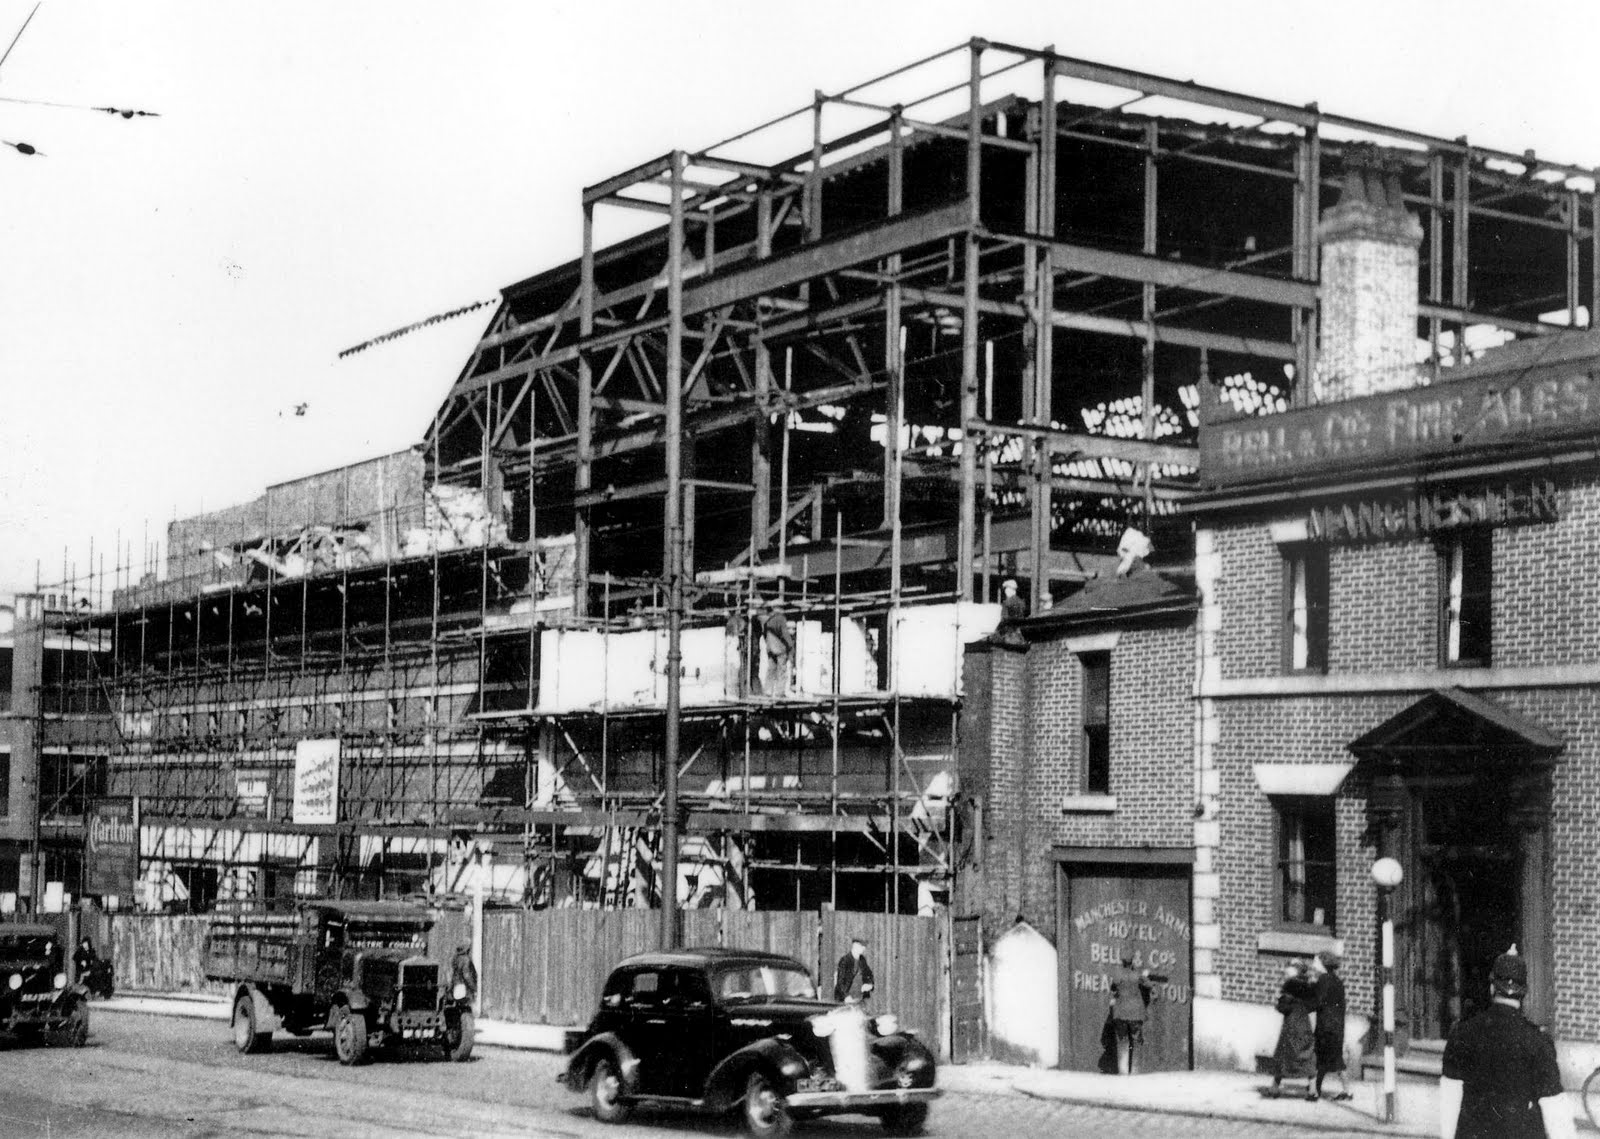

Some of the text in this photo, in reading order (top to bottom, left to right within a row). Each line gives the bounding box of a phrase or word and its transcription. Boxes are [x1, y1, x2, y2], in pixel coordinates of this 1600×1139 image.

[1475, 375, 1588, 429] ALES
[1307, 479, 1557, 541] MANCHESTER
[1074, 900, 1147, 933] MANCHESTER
[1108, 920, 1157, 941] HOTEL
[1091, 943, 1122, 965] BELL
[1132, 950, 1143, 967] &
[1074, 970, 1100, 992] FINE
